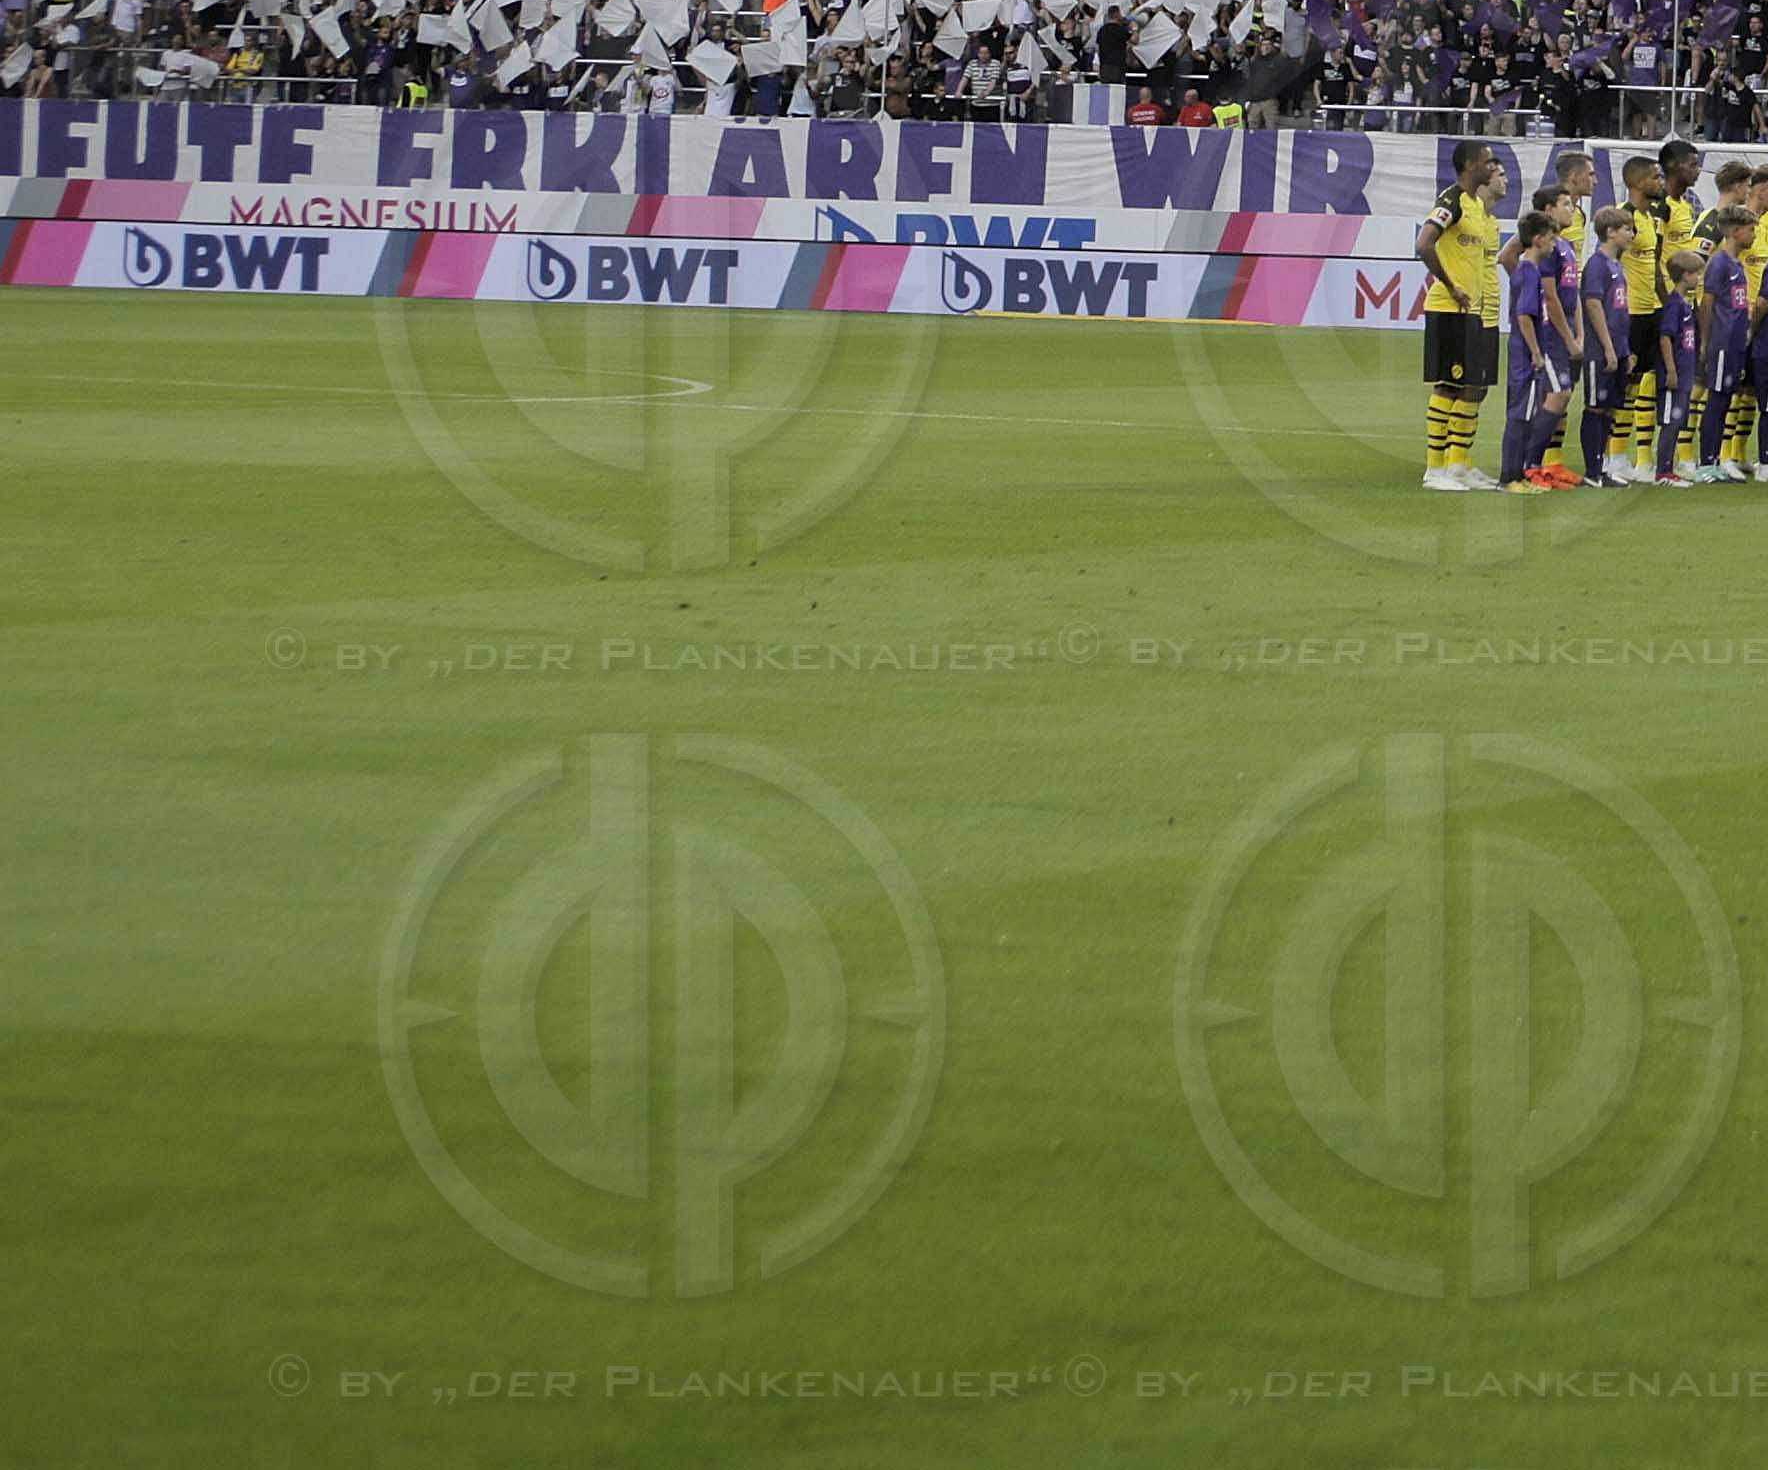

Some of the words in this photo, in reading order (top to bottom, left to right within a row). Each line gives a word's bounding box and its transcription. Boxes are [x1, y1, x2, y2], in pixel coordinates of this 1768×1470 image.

[1110, 124, 1376, 216] WIR
[182, 231, 330, 292] BWT
[587, 245, 740, 305] BWT
[1011, 257, 1159, 318] BWT
